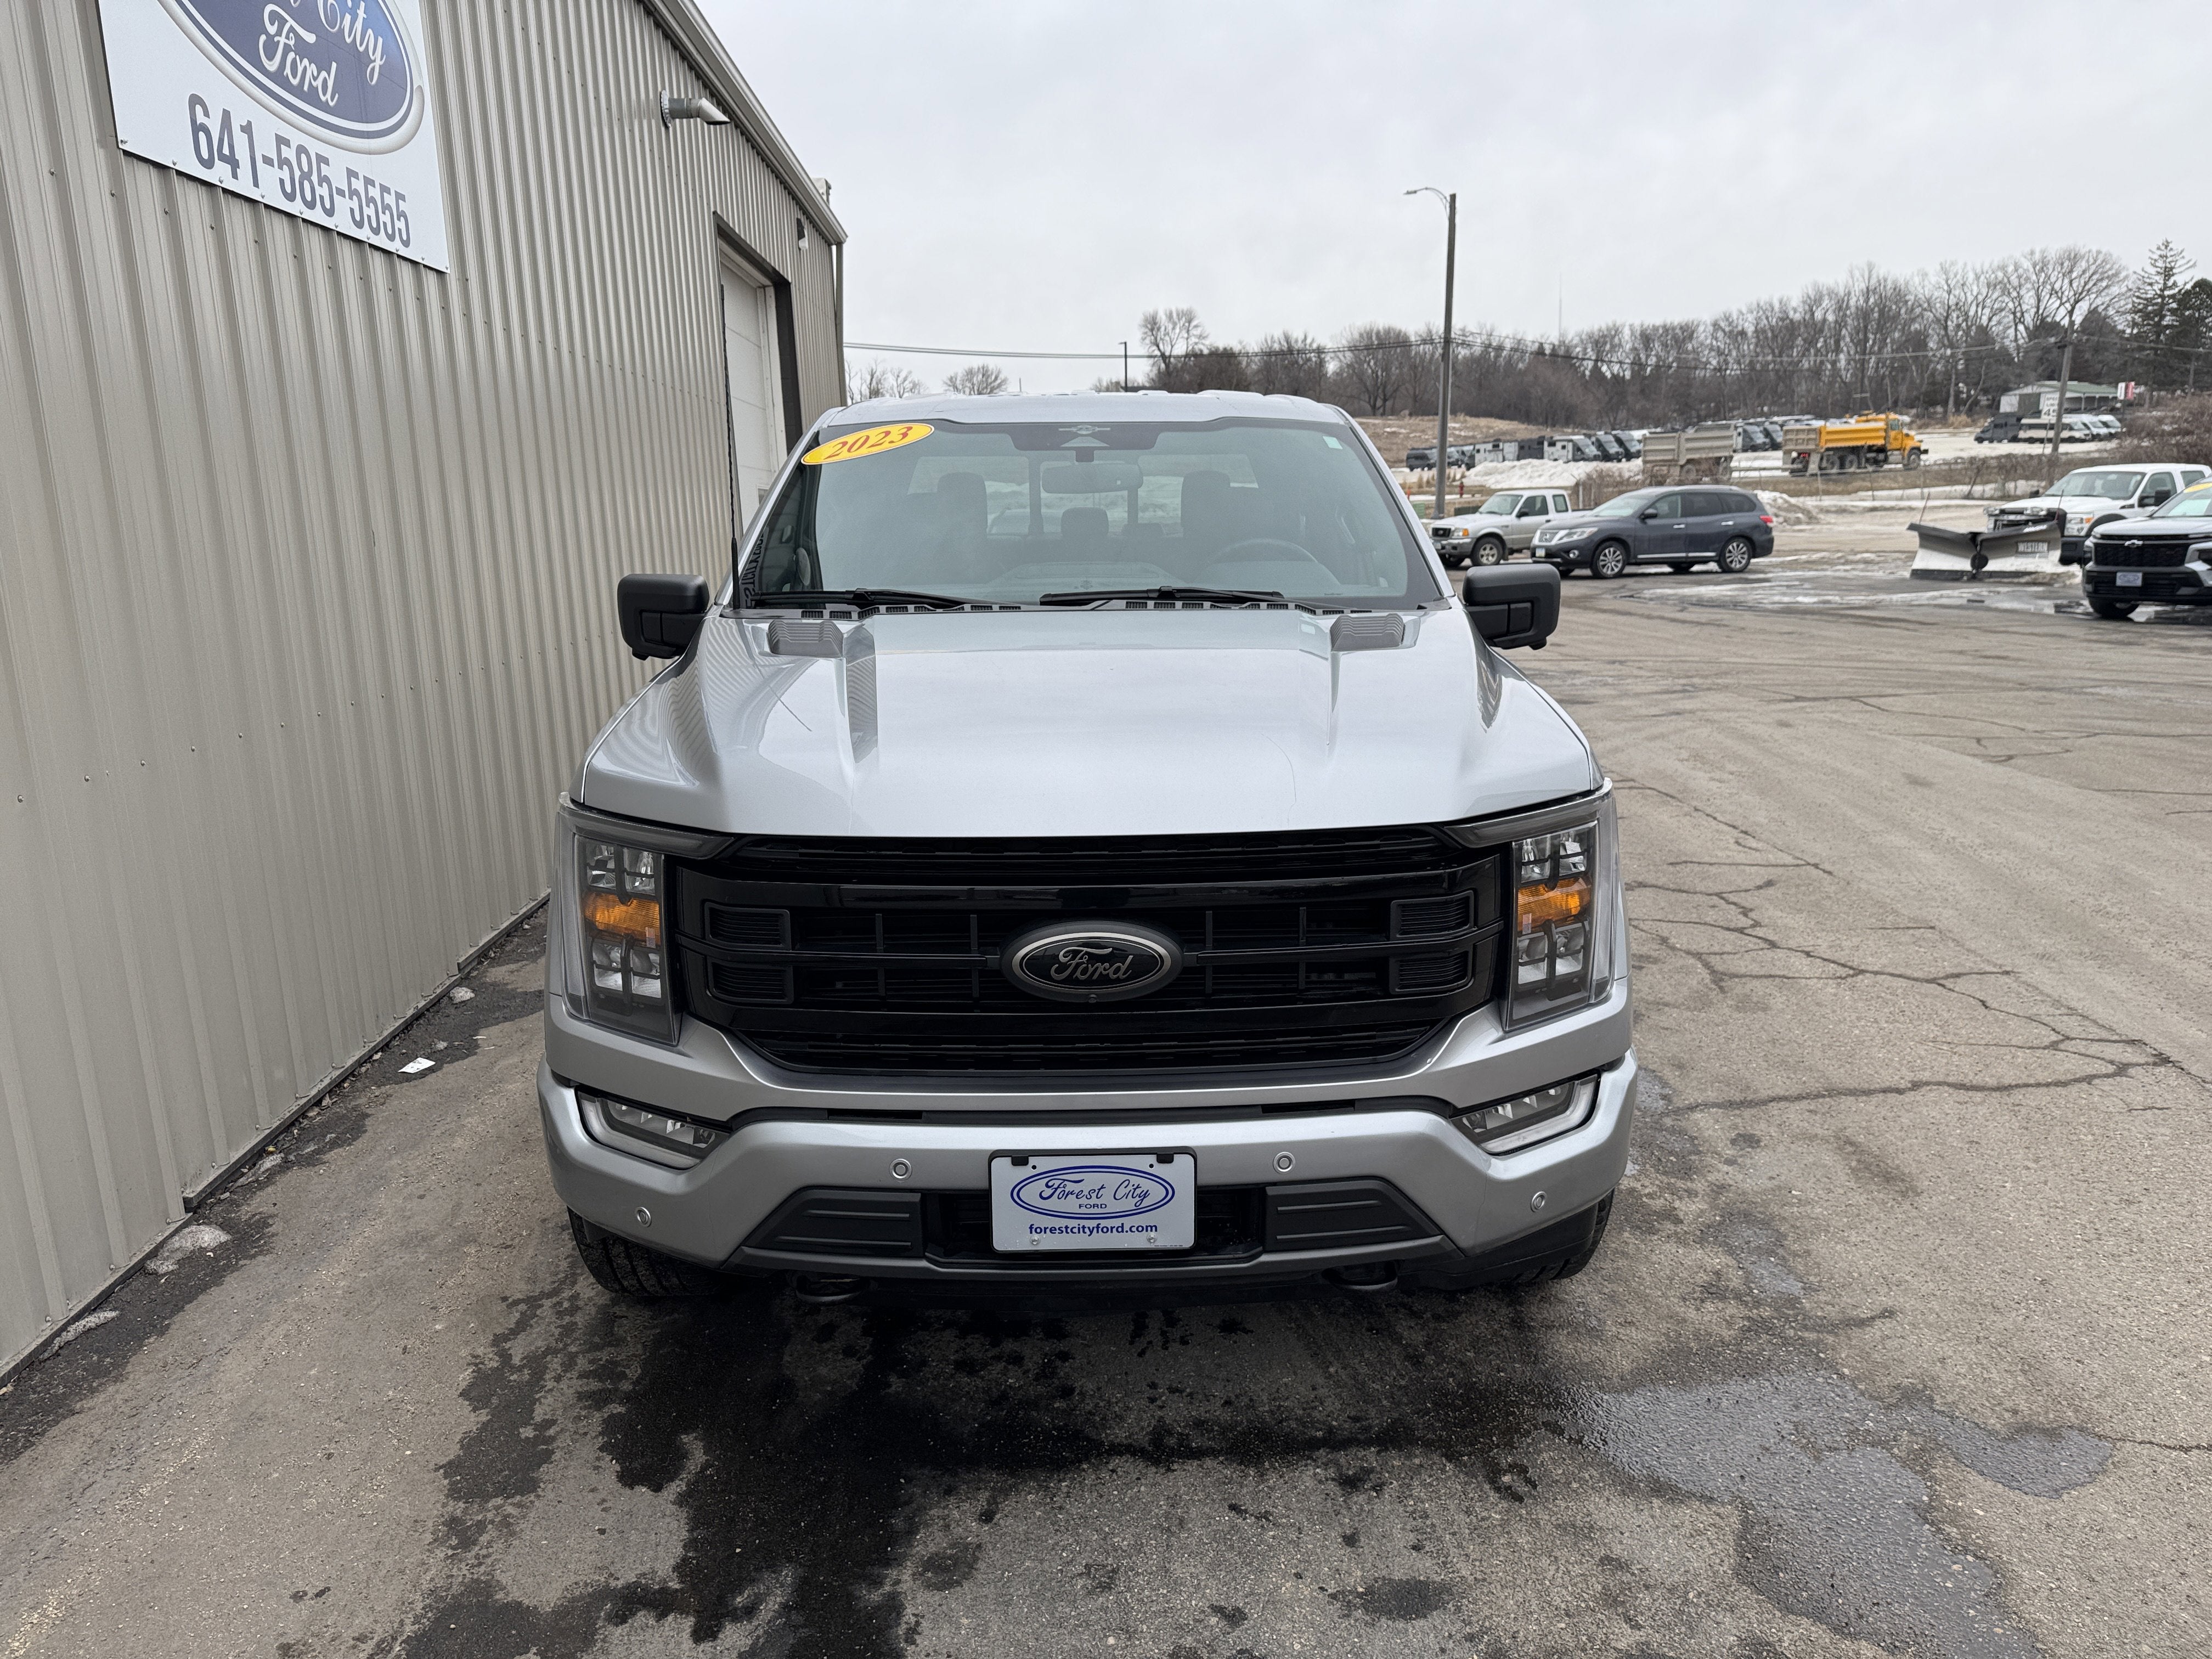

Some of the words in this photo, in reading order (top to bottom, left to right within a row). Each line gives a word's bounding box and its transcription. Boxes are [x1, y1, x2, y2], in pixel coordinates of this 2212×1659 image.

[259, 4, 338, 106] Ford
[188, 93, 411, 249] 641-585-5555
[823, 426, 913, 460] 2023
[1051, 947, 1133, 981] Ford
[1039, 1178, 1106, 1200] Forest
[1113, 1179, 1150, 1207] City
[1029, 1223, 1158, 1237] forestcityford.com
